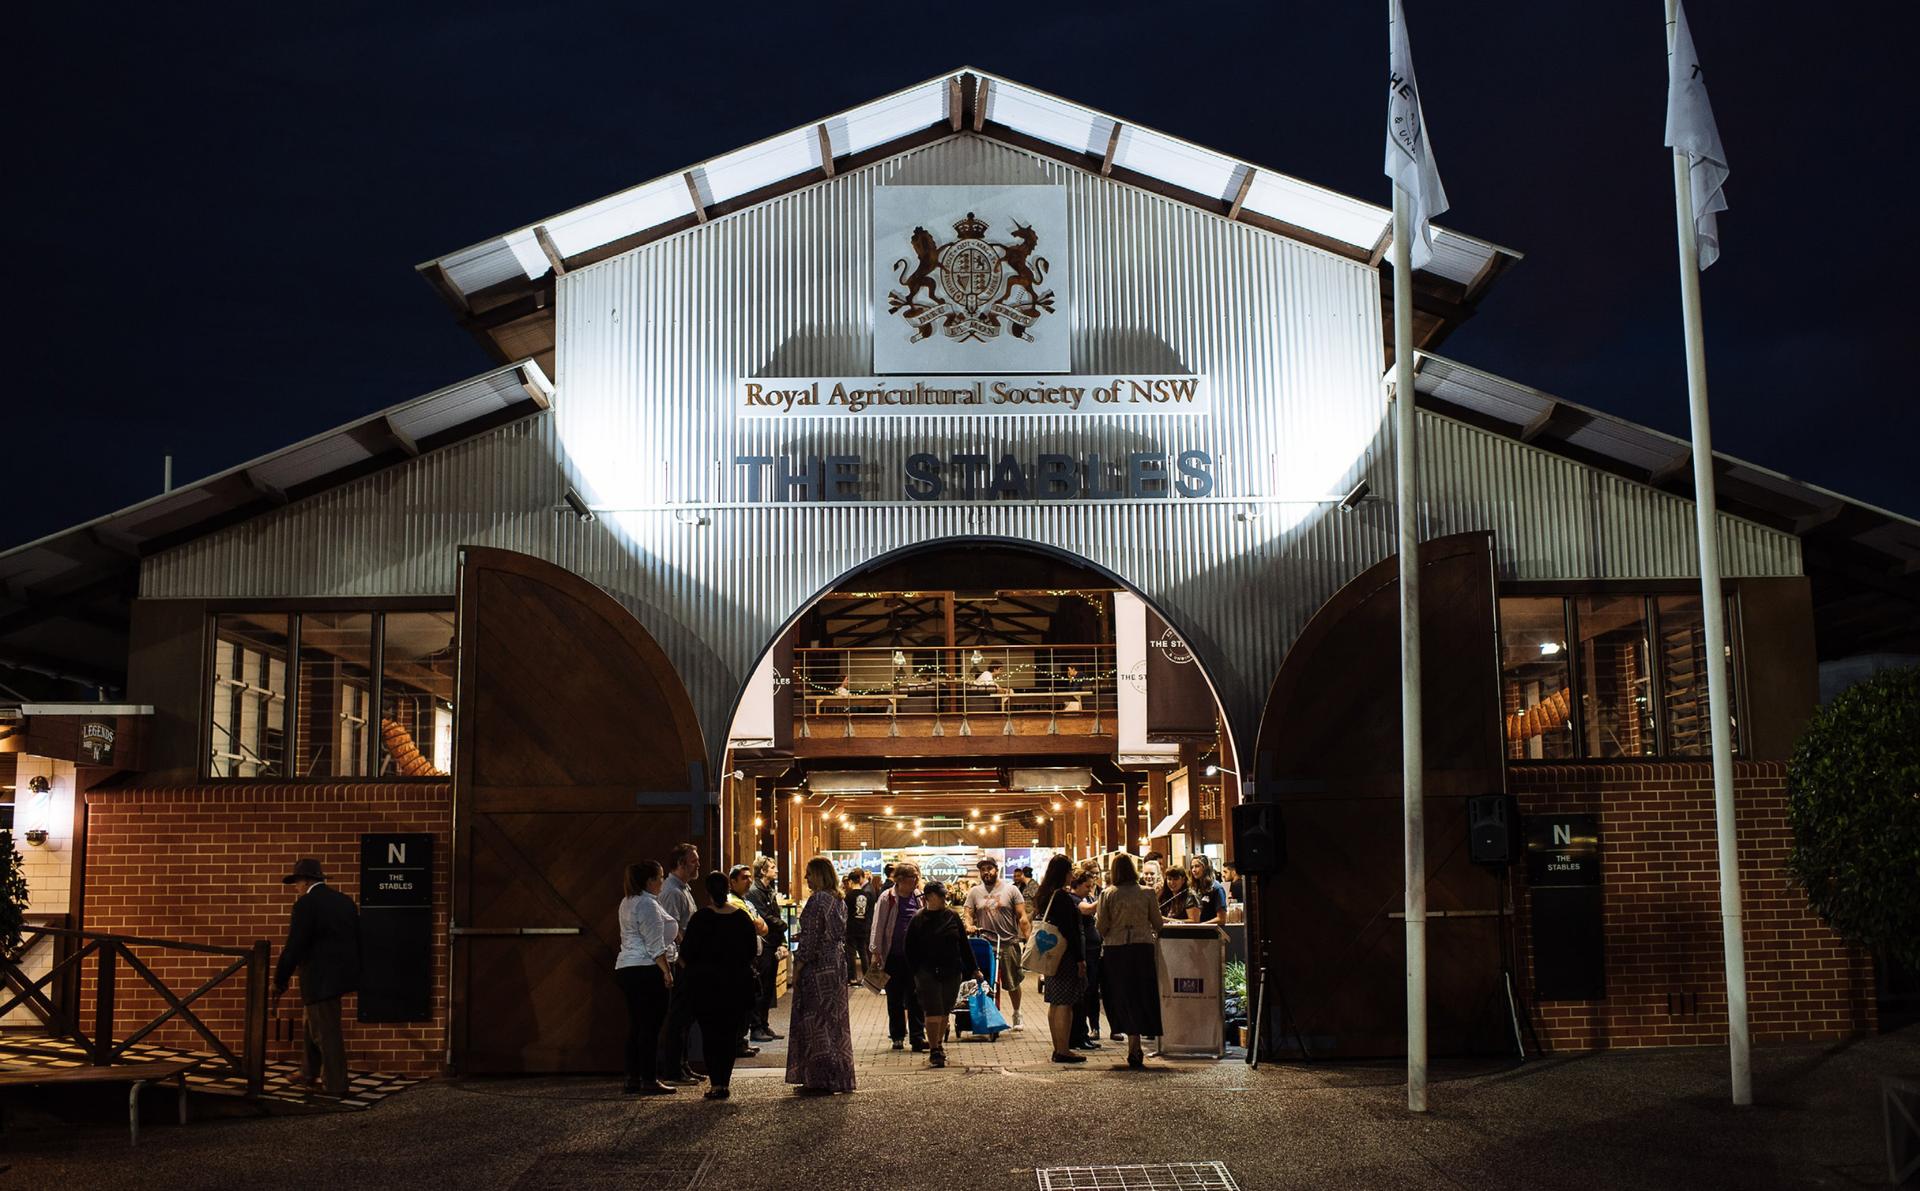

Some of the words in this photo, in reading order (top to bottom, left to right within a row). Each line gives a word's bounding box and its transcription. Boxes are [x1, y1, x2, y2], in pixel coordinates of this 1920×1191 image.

[744, 382, 821, 413] Royal
[825, 381, 984, 413] Agricultural
[991, 380, 1085, 411] Society
[1092, 378, 1125, 404] of
[1128, 378, 1200, 404] NSW
[736, 455, 861, 502] THE
[904, 449, 1214, 502] STABLES
[1150, 640, 1168, 648] THE
[83, 723, 114, 743] LEGENDS
[1553, 824, 1571, 845] N
[388, 842, 406, 864] N
[932, 868, 968, 876] STABLES
[1547, 863, 1581, 871] STABLES
[388, 873, 405, 881] THE
[378, 882, 413, 890] STABLES
